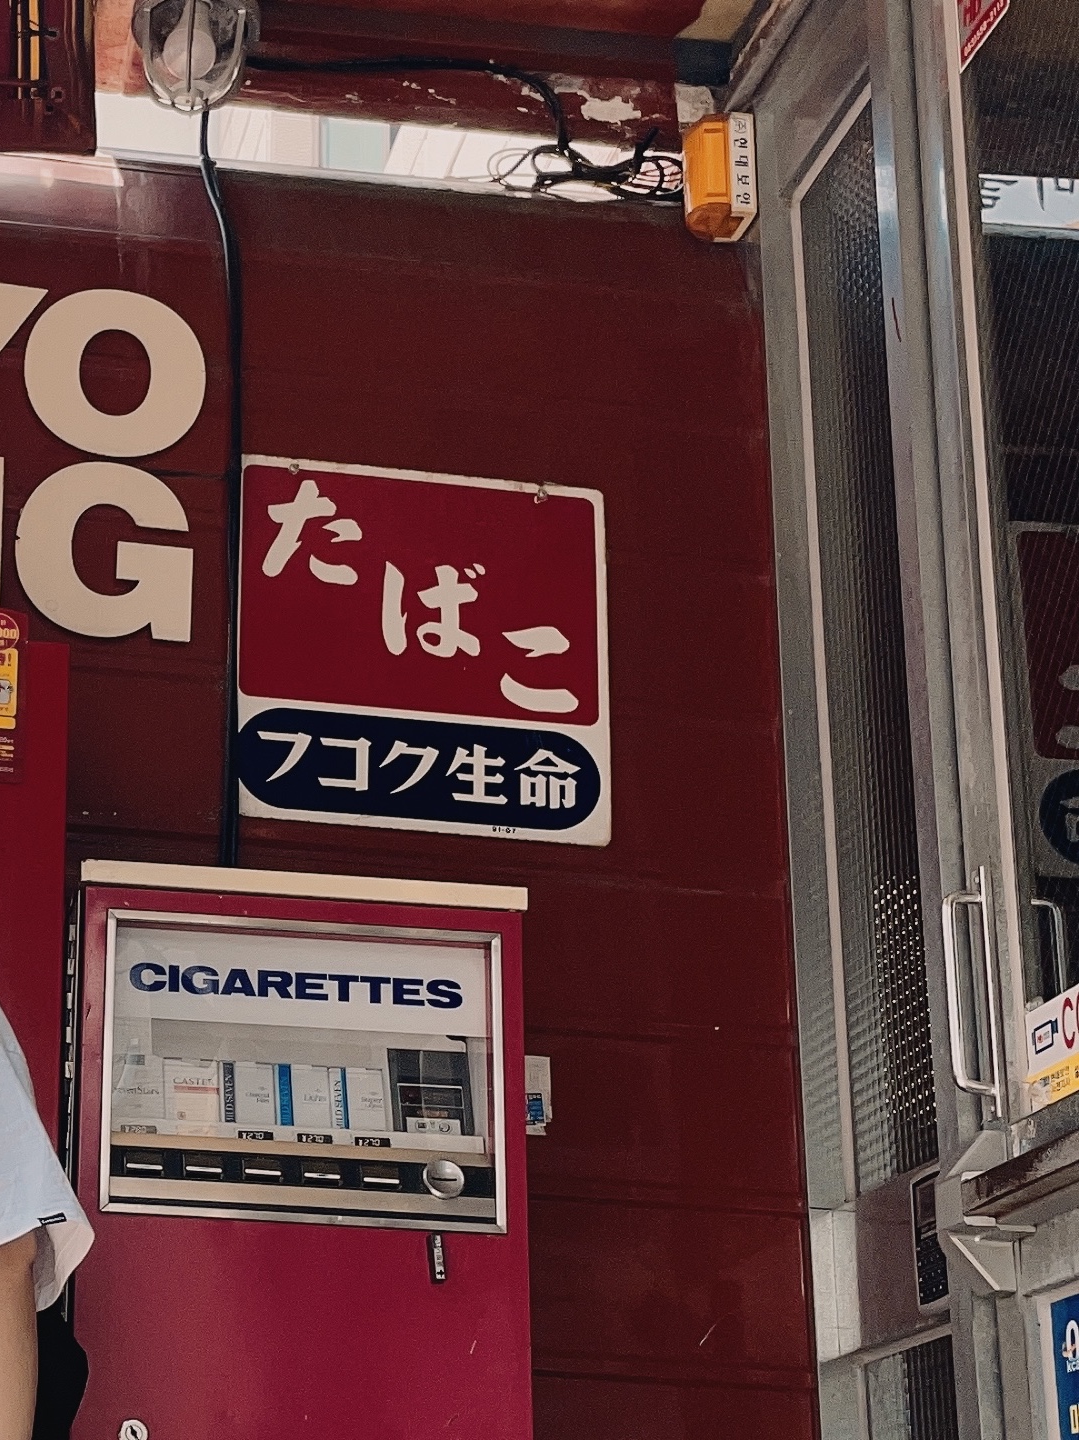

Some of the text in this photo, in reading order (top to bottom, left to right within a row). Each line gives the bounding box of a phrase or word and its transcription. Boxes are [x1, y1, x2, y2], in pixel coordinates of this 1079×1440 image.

[261, 479, 580, 714] たばこ
[256, 730, 582, 810] フコク生命
[128, 962, 464, 1009] CIGARETTES
[1062, 990, 1079, 1050] C
[224, 1074, 233, 1103] SEVEN
[334, 1080, 343, 1108] SEVEN
